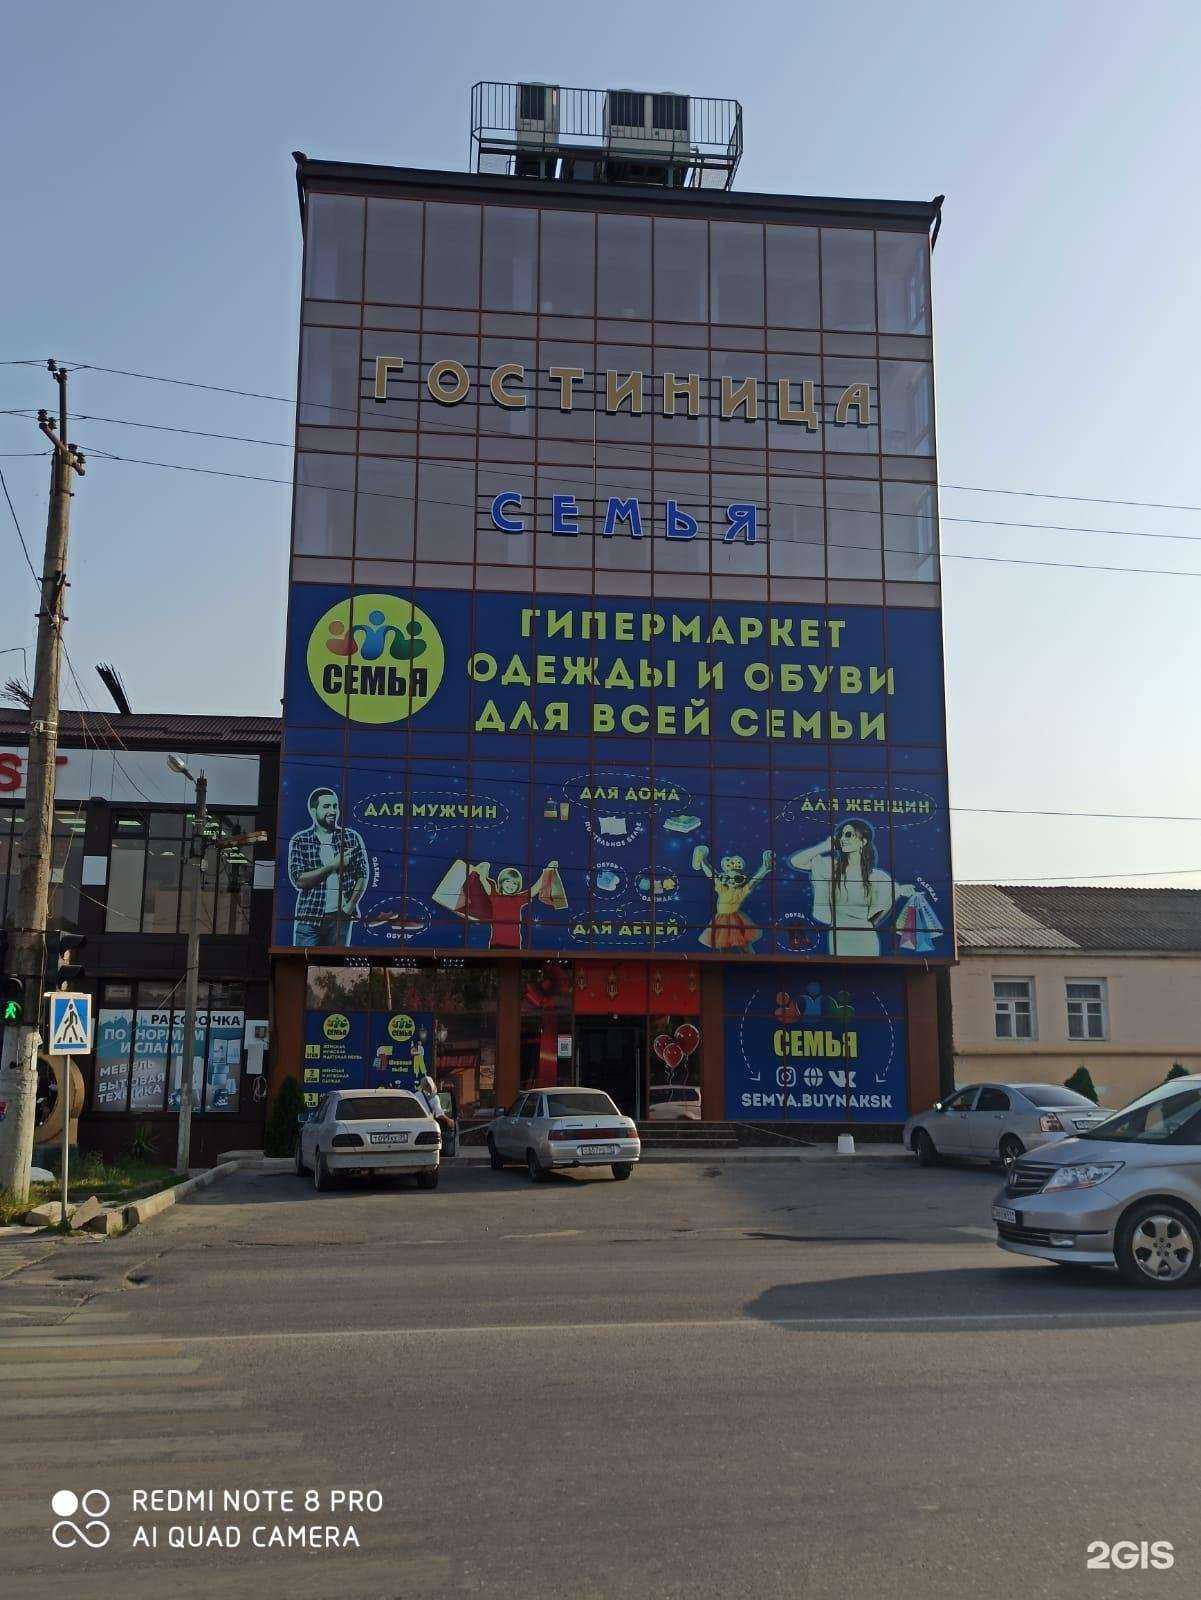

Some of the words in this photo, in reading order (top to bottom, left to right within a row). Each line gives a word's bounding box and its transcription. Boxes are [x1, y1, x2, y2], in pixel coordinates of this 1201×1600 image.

[374, 355, 870, 431] ГОСТИНИЦА
[491, 491, 757, 542] СЕМЬЯ
[521, 608, 845, 648] ГИПЕРМАРКЕТ
[322, 663, 428, 698] СЕМЬЯ
[467, 652, 676, 690] ОДЕЖДЫ
[698, 660, 724, 690] И
[744, 662, 895, 695] ОБУВИ
[475, 700, 569, 732] ДЛЯ
[593, 698, 710, 736] ВСЕЙ
[730, 708, 886, 741] СЕМЬИ
[580, 787, 618, 800] ДЛЯ
[625, 787, 680, 801] ДОМА
[364, 803, 404, 817] ДЛЯ
[412, 804, 497, 819] МУЖЧИН
[801, 798, 839, 812] ДЛЯ
[845, 799, 930, 814] ЖЕНЩИН
[585, 821, 626, 847] ПОТЕЛЬНОЕ
[573, 924, 612, 935] ДЛЯ
[618, 918, 678, 936] ДЕТЕЙ
[151, 1014, 241, 1026] РАСОЧКА
[104, 1028, 127, 1041] ПО
[135, 1028, 205, 1041] НОРММ
[773, 1029, 858, 1058] СЕМЬЯ
[120, 1041, 185, 1055] ИСЛАМ
[741, 1092, 893, 1108] SEMYA.BUYNAKSK
